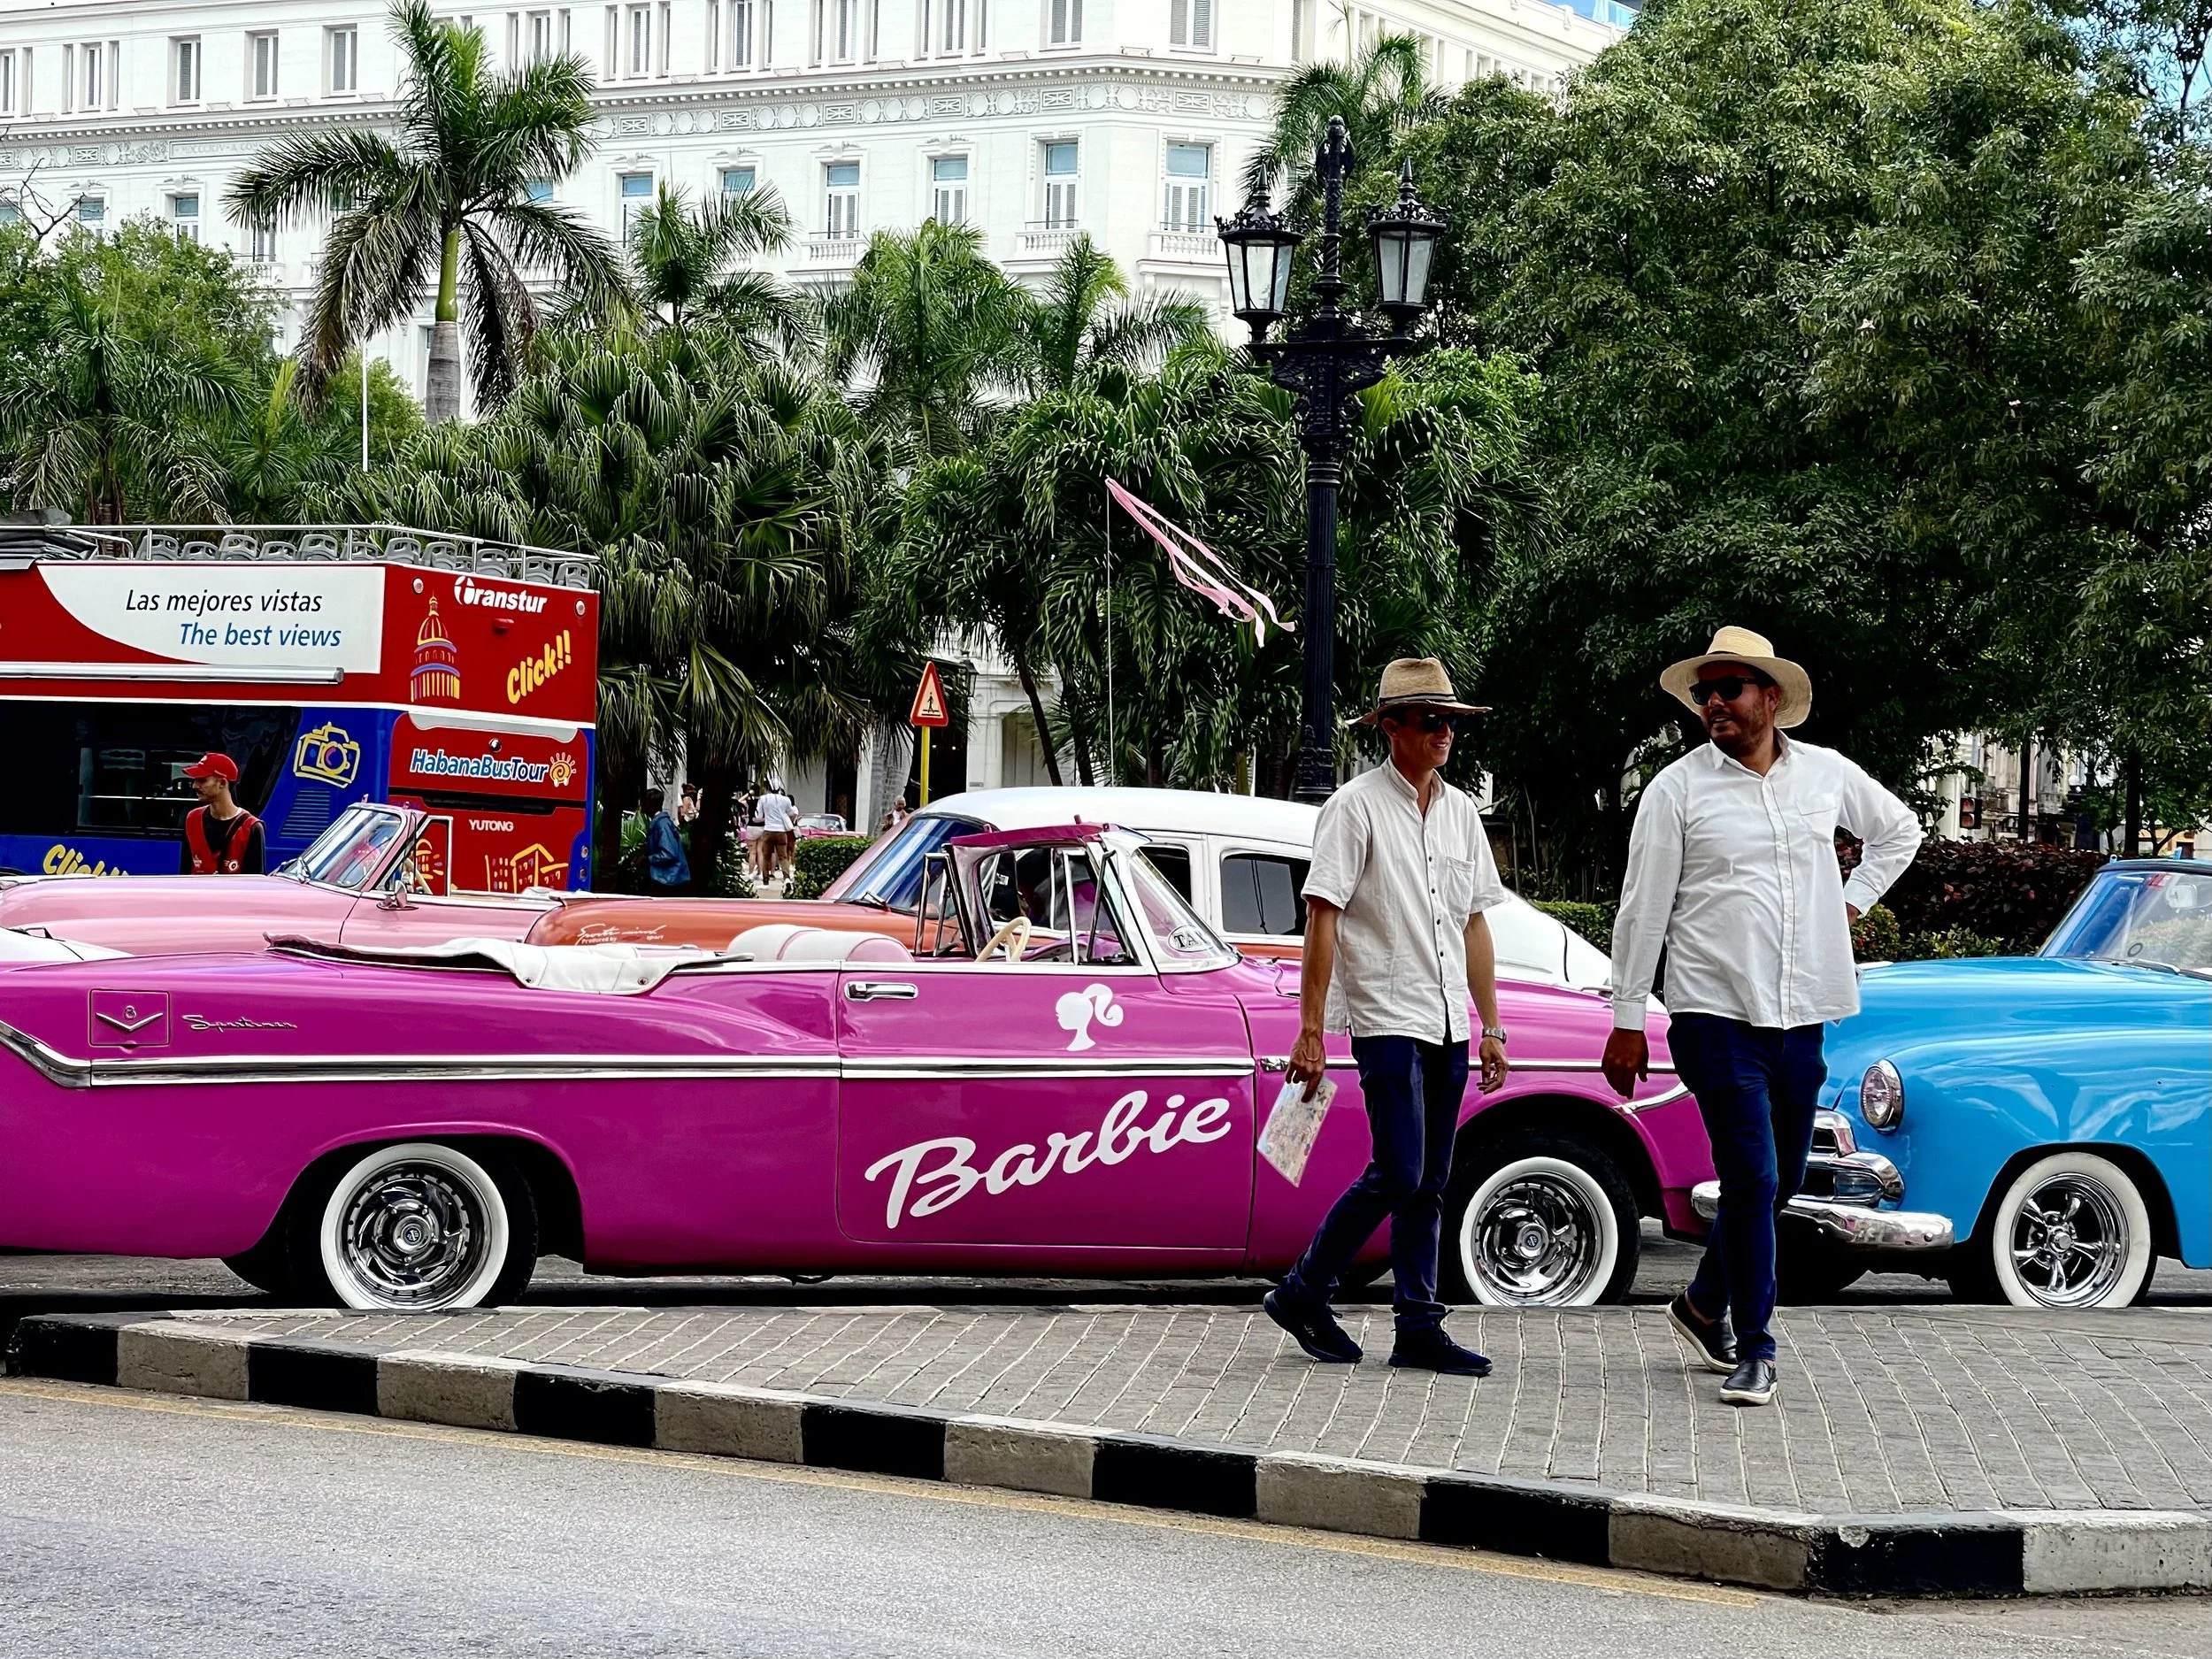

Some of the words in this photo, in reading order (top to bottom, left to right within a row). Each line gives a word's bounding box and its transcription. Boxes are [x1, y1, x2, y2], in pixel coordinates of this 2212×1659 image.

[126, 589, 160, 611] Las
[166, 588, 253, 617] mejores
[261, 588, 323, 612] vistas
[180, 622, 218, 645] The
[224, 622, 273, 646] best
[279, 624, 342, 647] views
[507, 629, 572, 704] Click!!
[410, 749, 549, 783] HabanaBusTour
[469, 819, 514, 833] YUTONG
[864, 1090, 1232, 1229] Barbie
